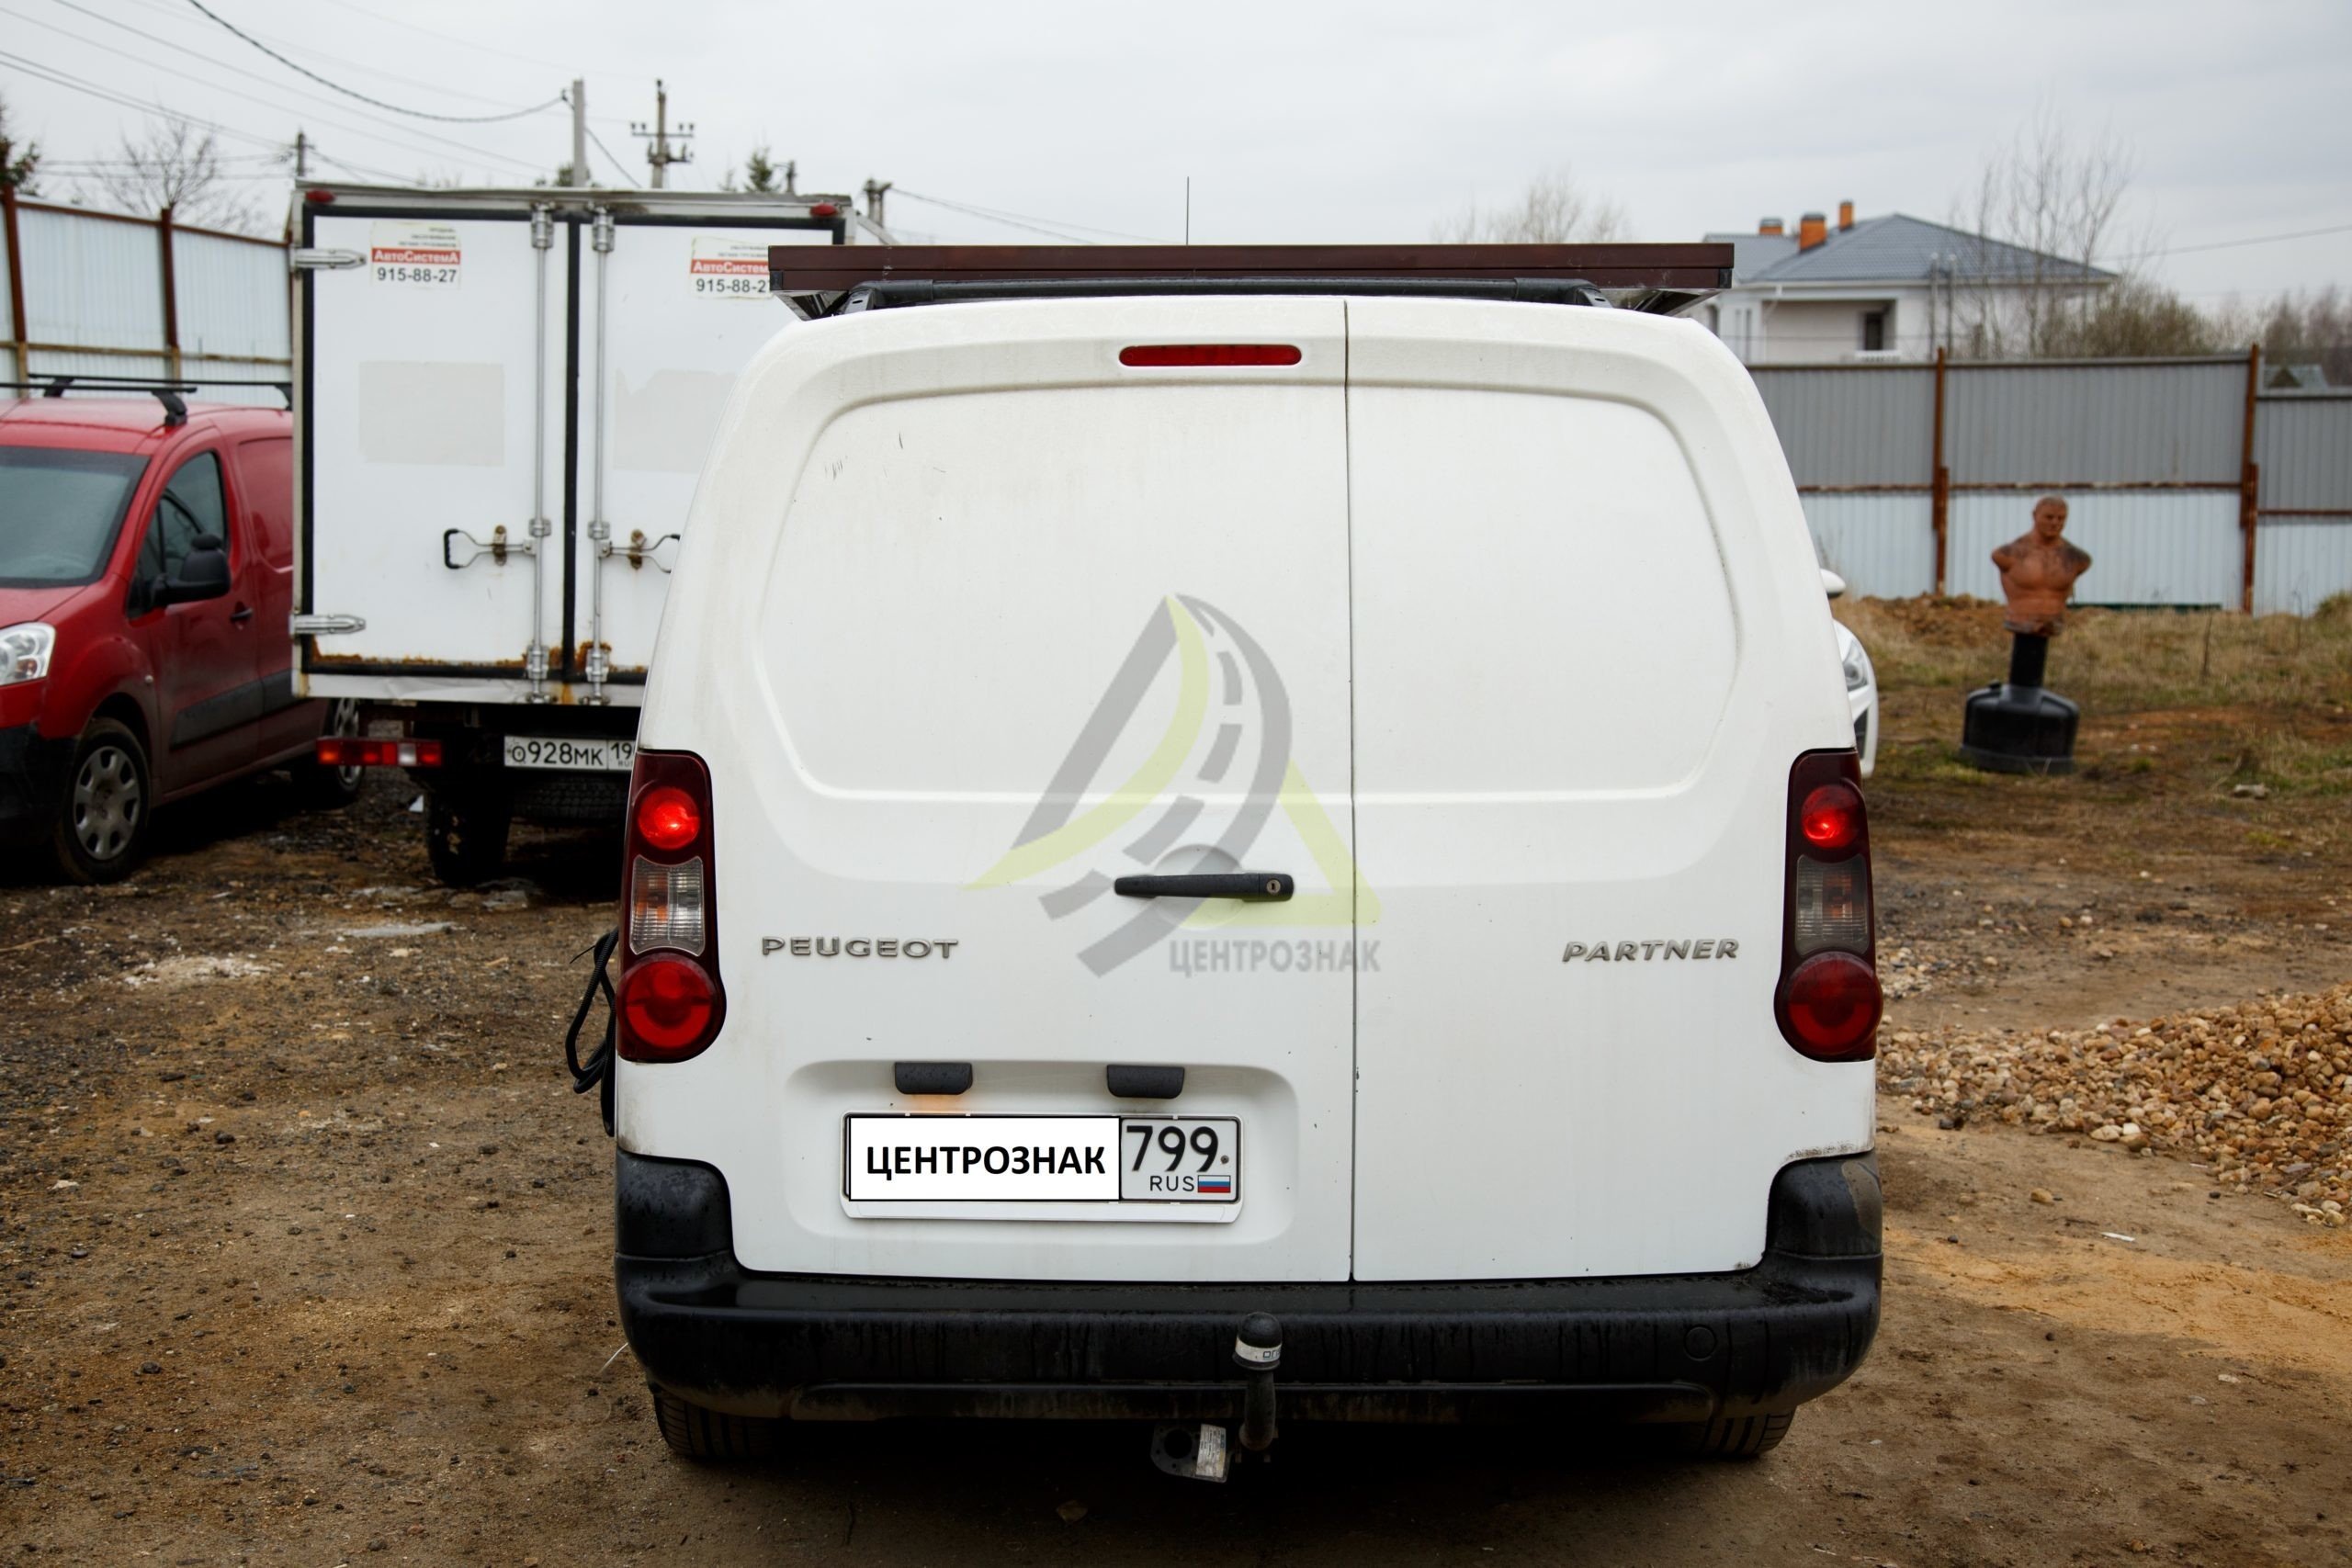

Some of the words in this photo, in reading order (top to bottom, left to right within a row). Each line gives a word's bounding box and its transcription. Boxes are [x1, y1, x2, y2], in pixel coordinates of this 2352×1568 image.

[377, 267, 458, 283] 915-88-27
[693, 261, 769, 274] АвтоСистем
[695, 278, 770, 293] 915-88-2
[610, 742, 635, 761] 19
[762, 935, 959, 959] PEUGEOT
[1562, 938, 1740, 963] PARTNER
[1126, 1125, 1219, 1172] 799
[1149, 1175, 1195, 1192] RUS
